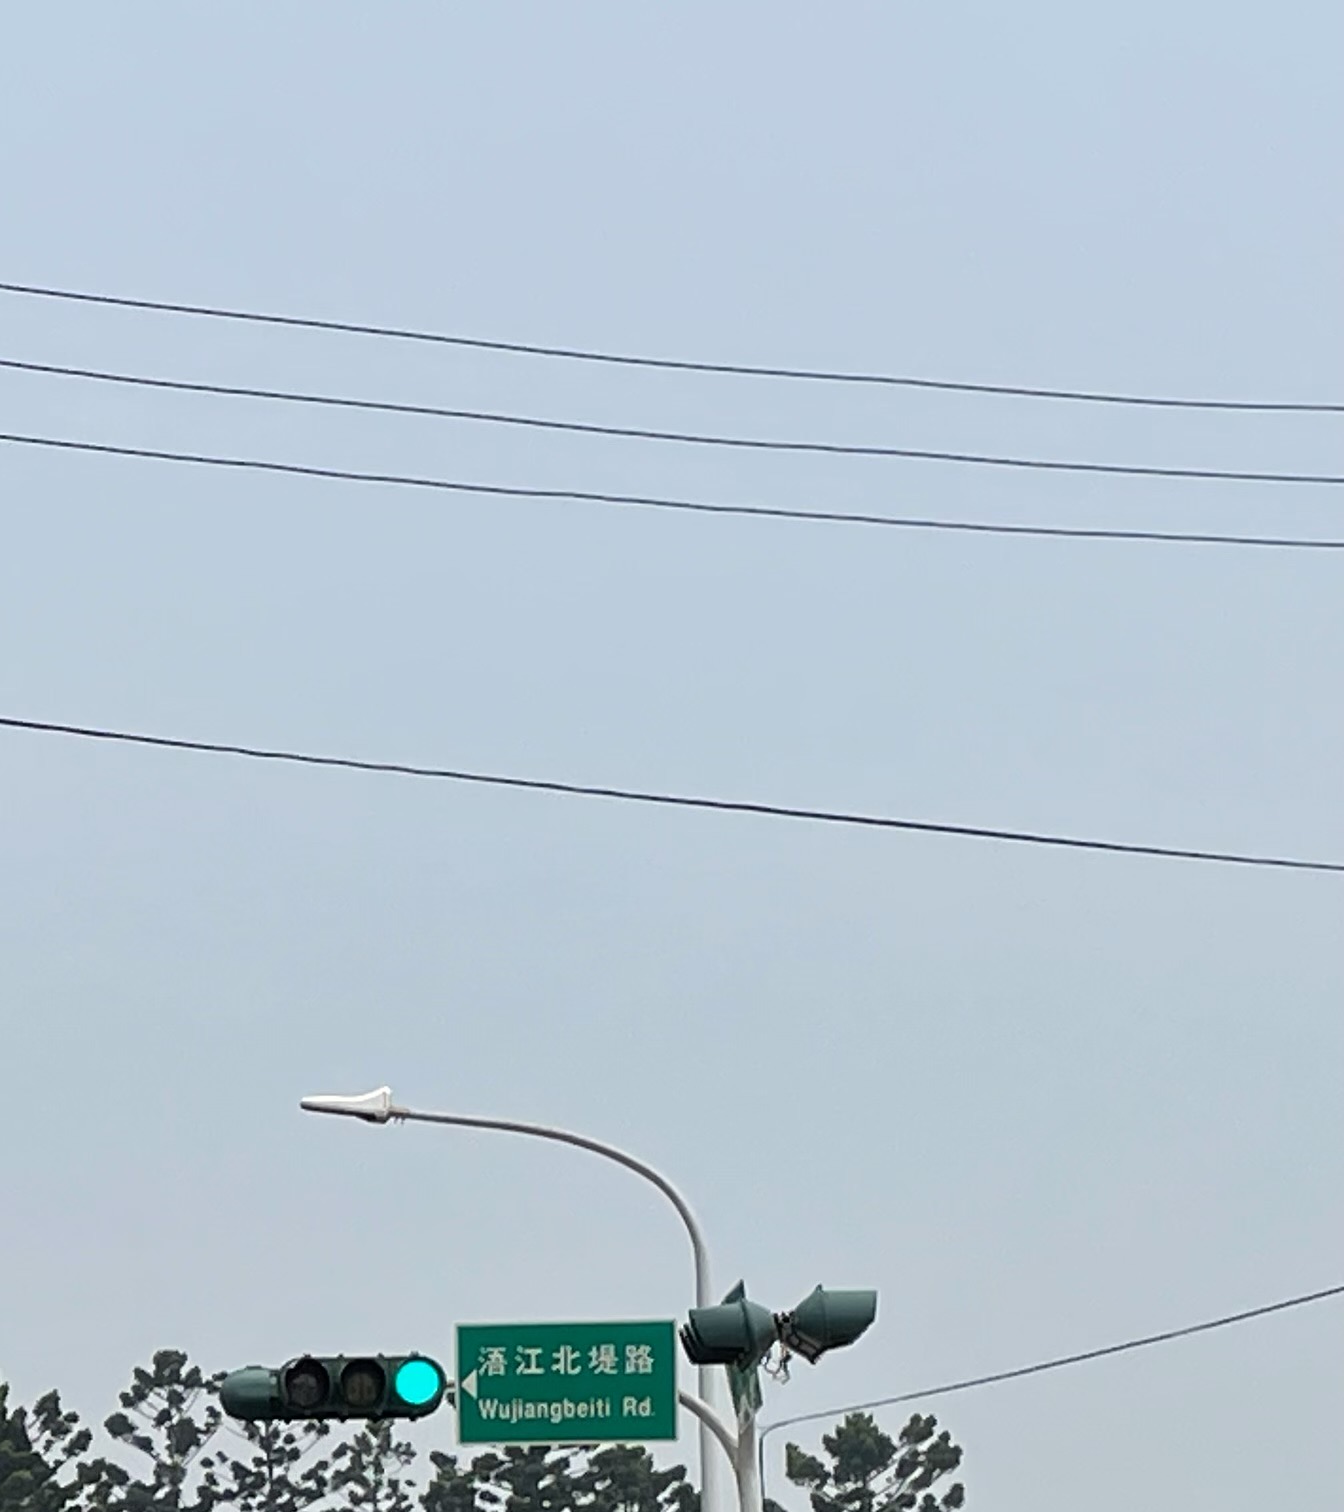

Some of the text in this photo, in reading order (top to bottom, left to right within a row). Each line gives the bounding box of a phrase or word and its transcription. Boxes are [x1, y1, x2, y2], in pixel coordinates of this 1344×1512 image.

[478, 1344, 654, 1376] 浯江北堤路
[478, 1397, 610, 1424] Wujiangbeiti
